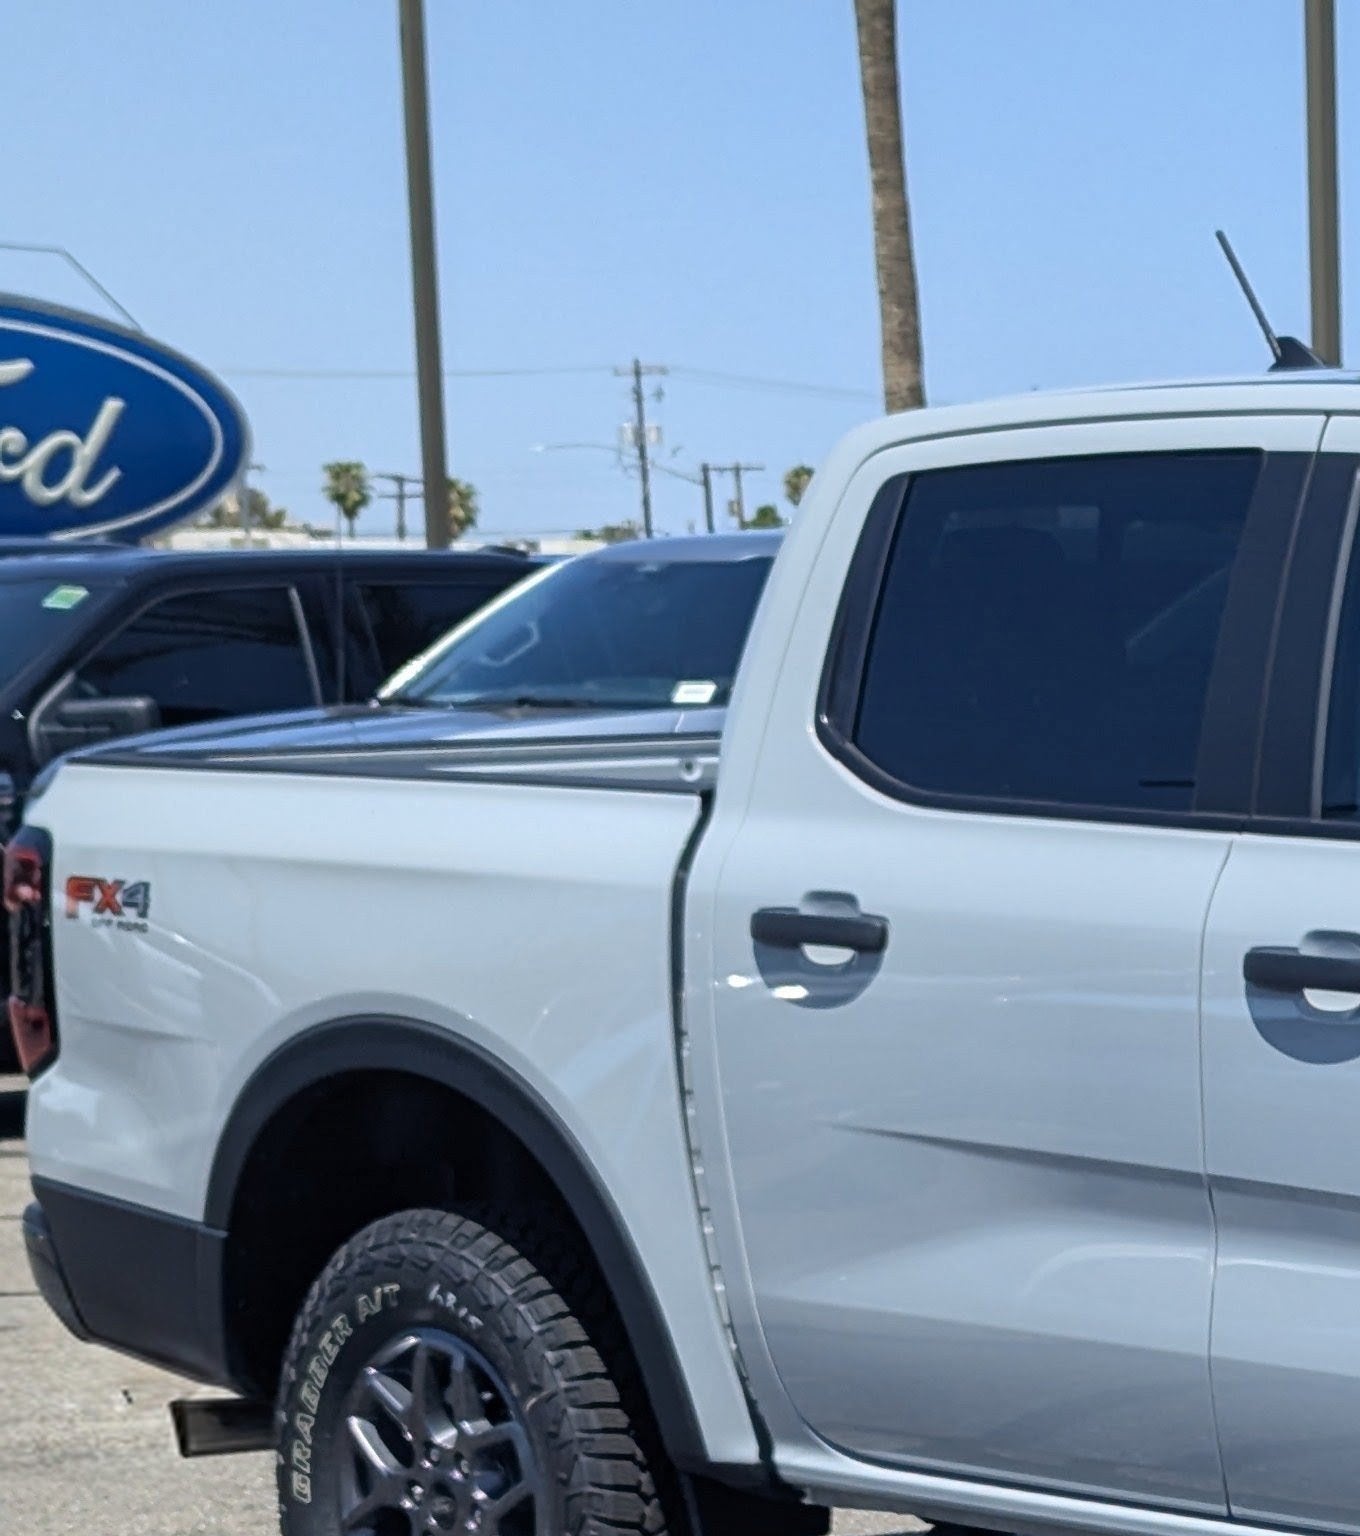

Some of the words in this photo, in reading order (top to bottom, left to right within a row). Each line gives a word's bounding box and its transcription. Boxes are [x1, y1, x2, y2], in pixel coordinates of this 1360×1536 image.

[66, 876, 150, 919] FX4
[292, 1313, 353, 1504] GRABBER
[355, 1282, 400, 1324] A/T
